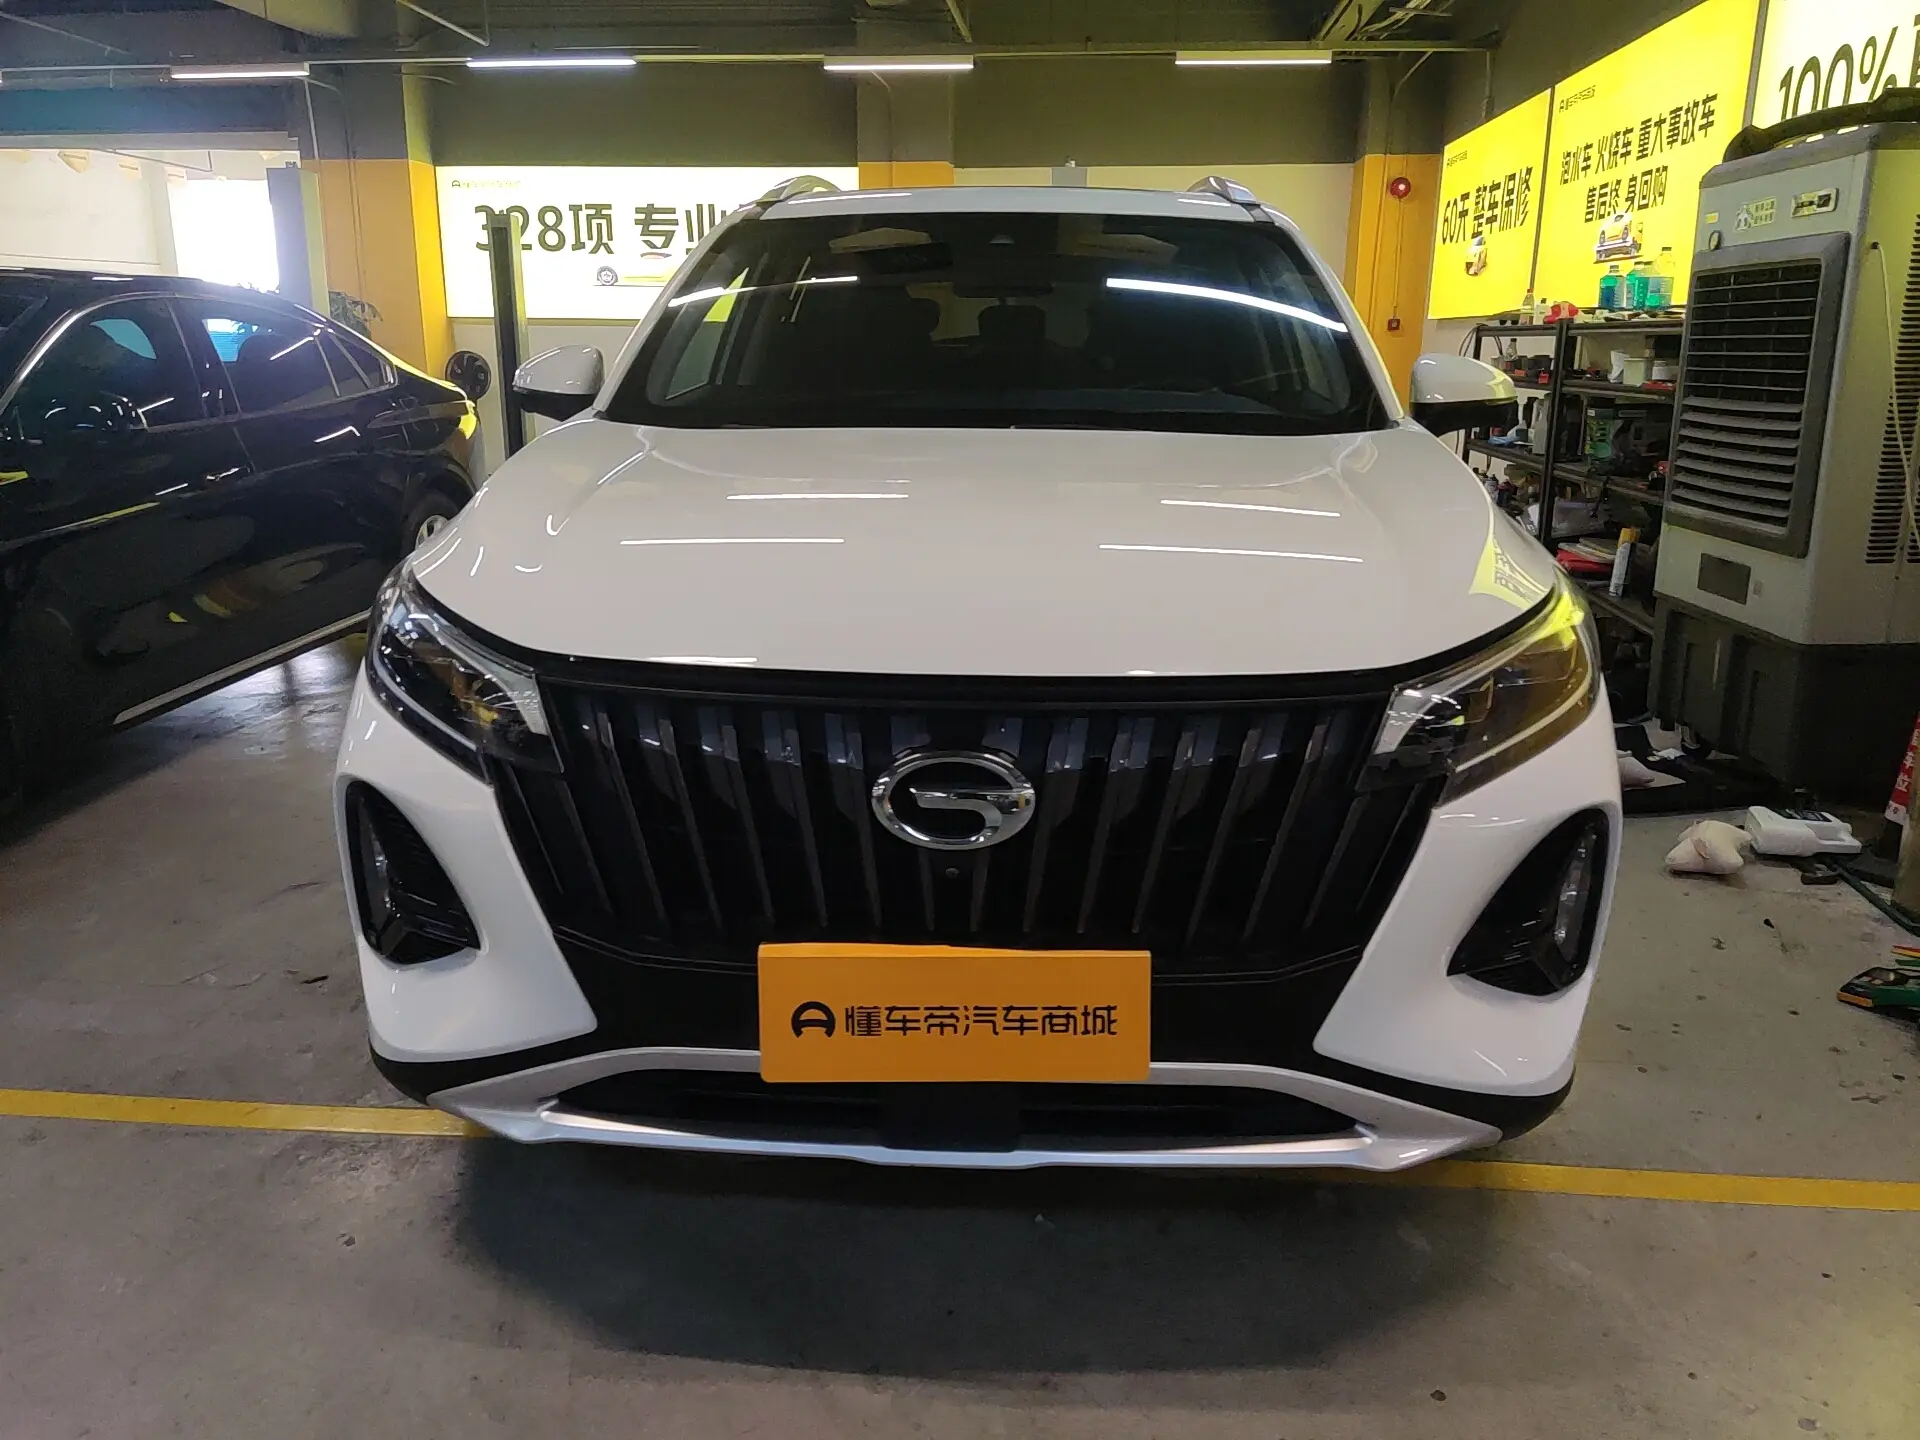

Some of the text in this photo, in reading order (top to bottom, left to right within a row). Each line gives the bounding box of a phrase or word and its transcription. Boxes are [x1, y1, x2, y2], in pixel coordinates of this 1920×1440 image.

[1779, 26, 1898, 121] 100%
[1560, 142, 1594, 186] 泡水车
[1595, 127, 1635, 174] 火烧车
[1636, 93, 1718, 161] 重大事故车
[1442, 166, 1533, 245] 60天 整车保修
[844, 1005, 1118, 1037] 懂车帝汽车商城
